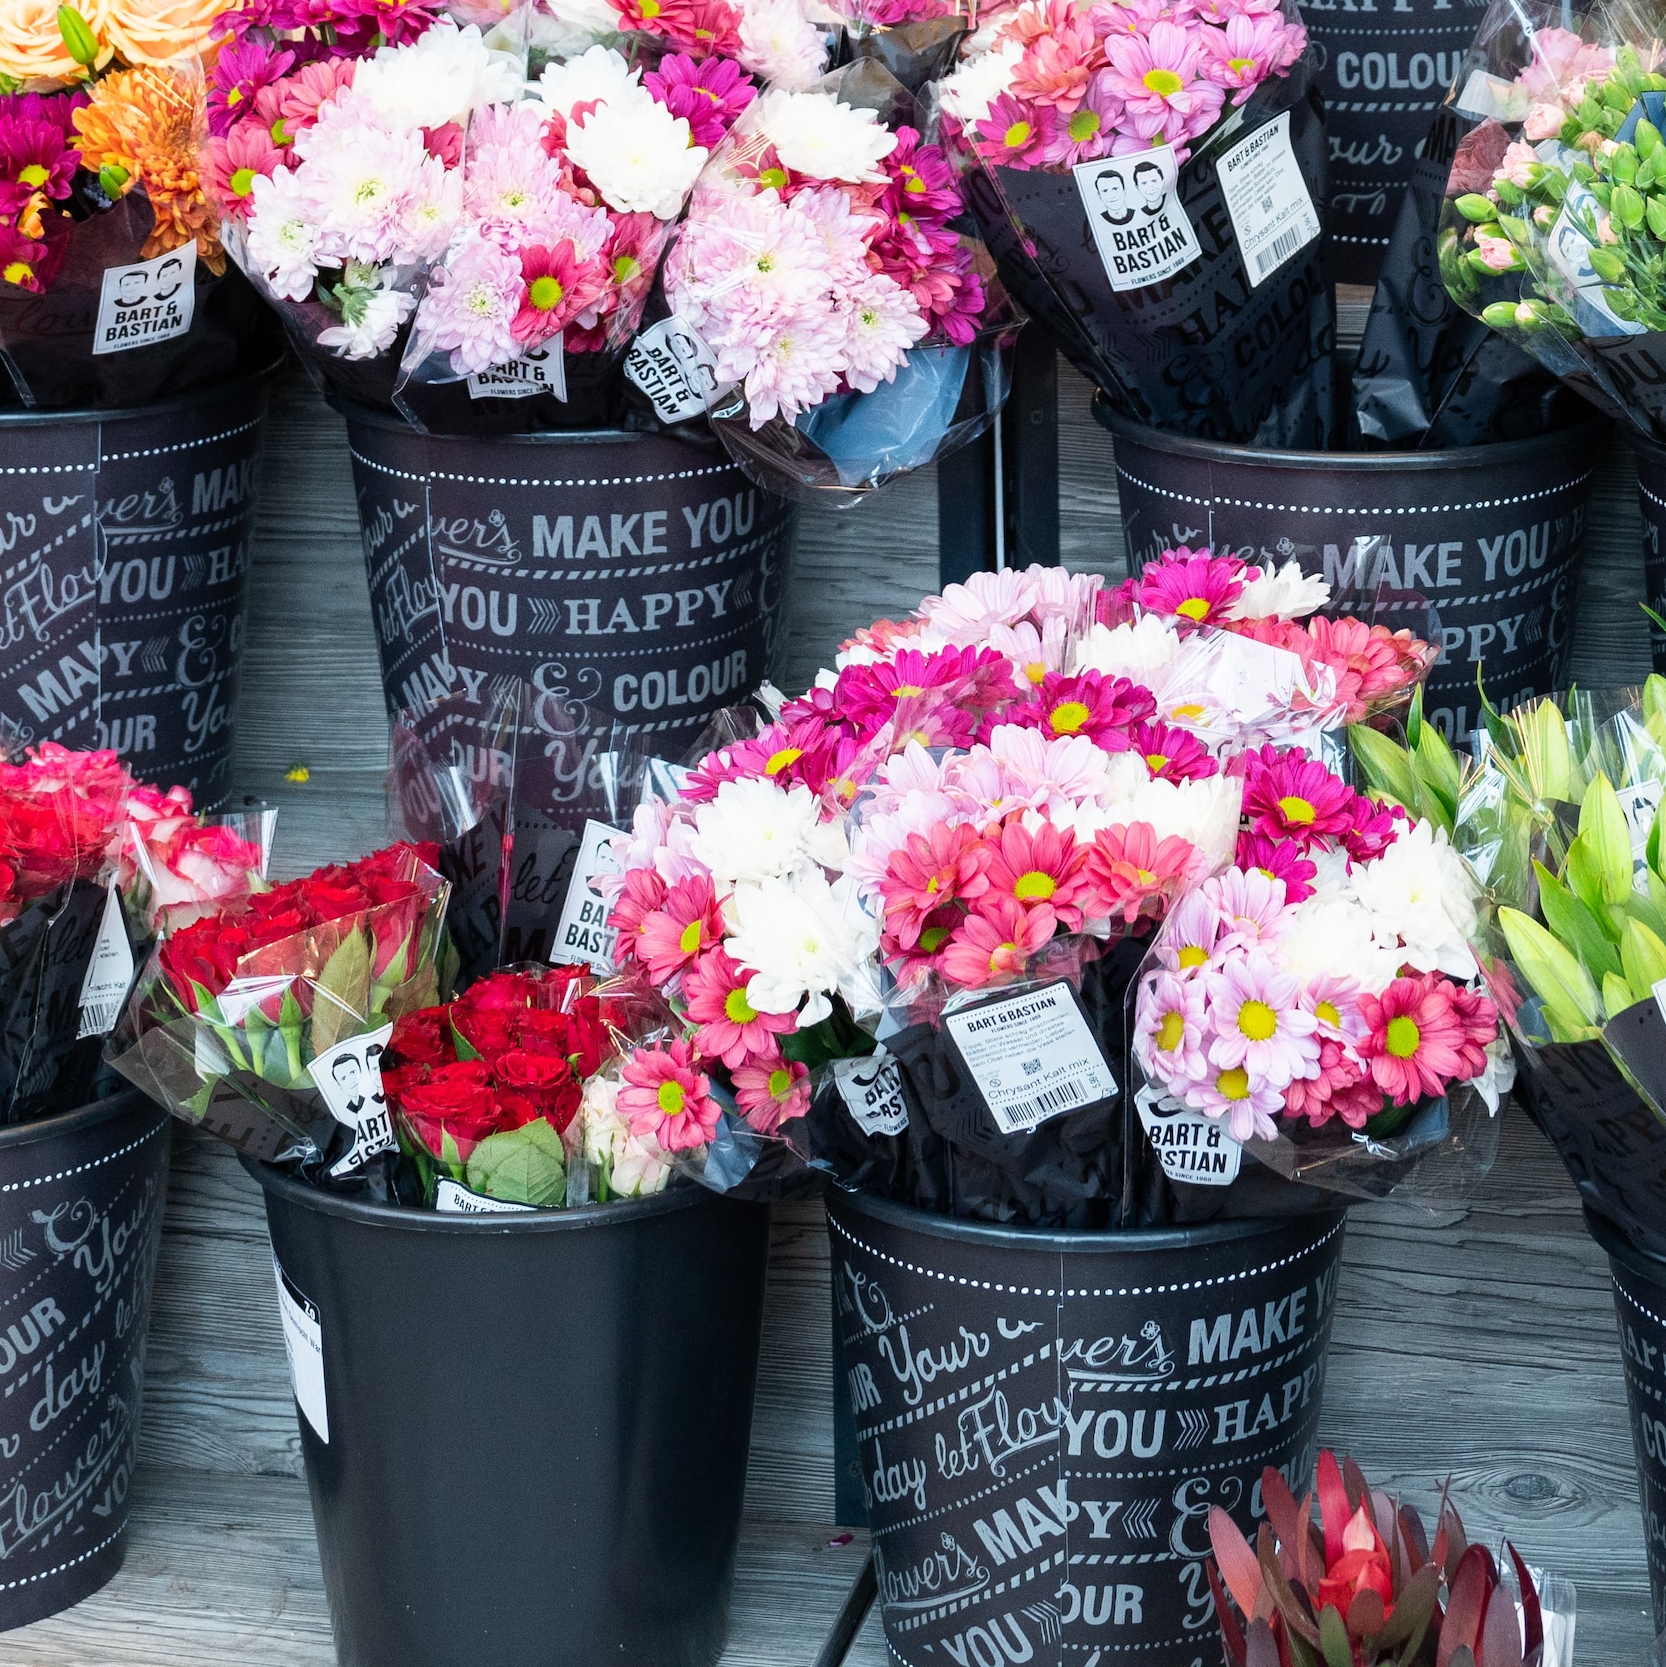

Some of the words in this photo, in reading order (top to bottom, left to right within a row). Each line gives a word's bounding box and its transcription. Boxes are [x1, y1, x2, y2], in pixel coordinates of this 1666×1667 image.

[1227, 150, 1245, 172] BART
[1250, 124, 1279, 151] BASTIAN
[1112, 229, 1158, 252] BART
[1159, 215, 1172, 235] &
[1244, 219, 1275, 250] Chrysant
[1275, 208, 1290, 224] Kalt
[1290, 197, 1304, 212] mix
[1113, 231, 1189, 275] BASTIAN
[1130, 270, 1156, 286] FLOWERS
[1157, 262, 1172, 275] SINCE
[105, 313, 183, 341] BASTIAN
[115, 304, 165, 325] BART
[166, 301, 178, 316] &
[534, 367, 545, 380] &
[630, 348, 681, 415] BASTIAN
[647, 347, 683, 387] BART
[676, 389, 690, 403] &
[532, 510, 669, 560] MAKE
[682, 489, 756, 545] YOU
[99, 554, 175, 605] YOU
[1322, 543, 1463, 590] MAKE
[1477, 528, 1551, 578] YOU
[439, 582, 519, 638] YOU
[563, 582, 734, 637] HAPPY
[613, 649, 748, 711] COLOUR
[967, 1015, 998, 1033] BART
[999, 1012, 1008, 1023] &
[1008, 996, 1057, 1022] BASTIAN
[991, 1024, 1014, 1034] FLOWERS
[1014, 1019, 1028, 1028] SINCE
[988, 1078, 1042, 1100] Chrysant
[1043, 1067, 1066, 1081] Kalt
[1068, 1058, 1090, 1070] mix
[1148, 1124, 1205, 1148] BART
[1206, 1124, 1222, 1142] &
[1188, 1298, 1307, 1367] MAKE
[28, 1340, 107, 1433] day
[879, 1316, 991, 1407] Your
[1066, 1409, 1168, 1460] YOU
[873, 1452, 928, 1513] day
[937, 1432, 978, 1483] let
